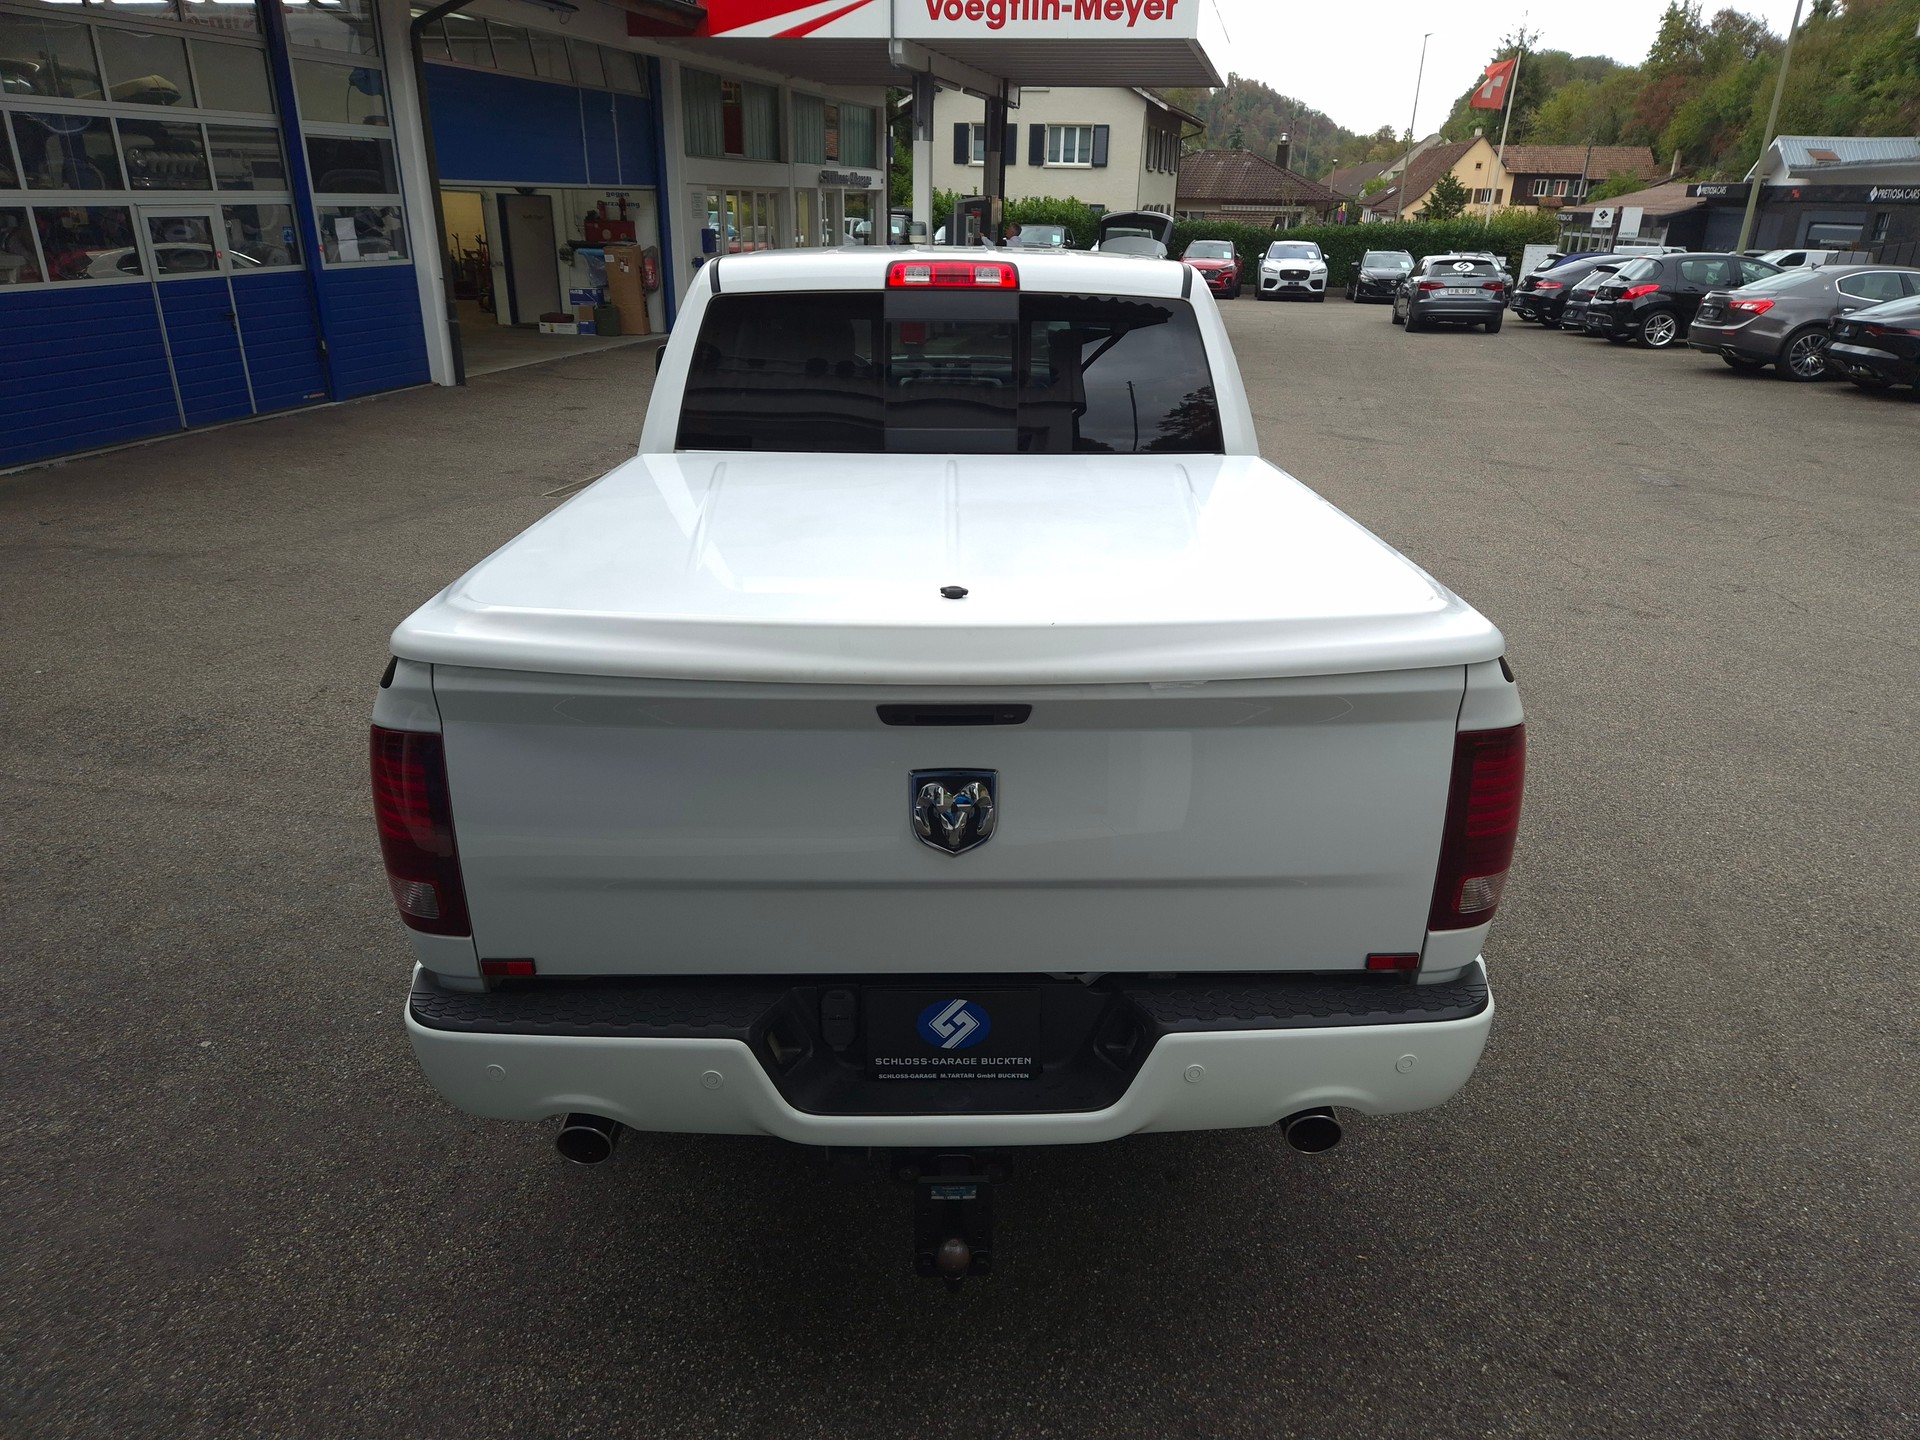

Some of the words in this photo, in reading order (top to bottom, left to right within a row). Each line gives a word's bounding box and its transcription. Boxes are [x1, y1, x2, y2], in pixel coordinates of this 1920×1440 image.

[1877, 188, 1904, 199] PRETIOSA
[1904, 188, 1920, 199] CARS
[875, 1057, 977, 1066] SCHLOSS-GARAGE
[981, 1057, 1032, 1065] BUCKTEN
